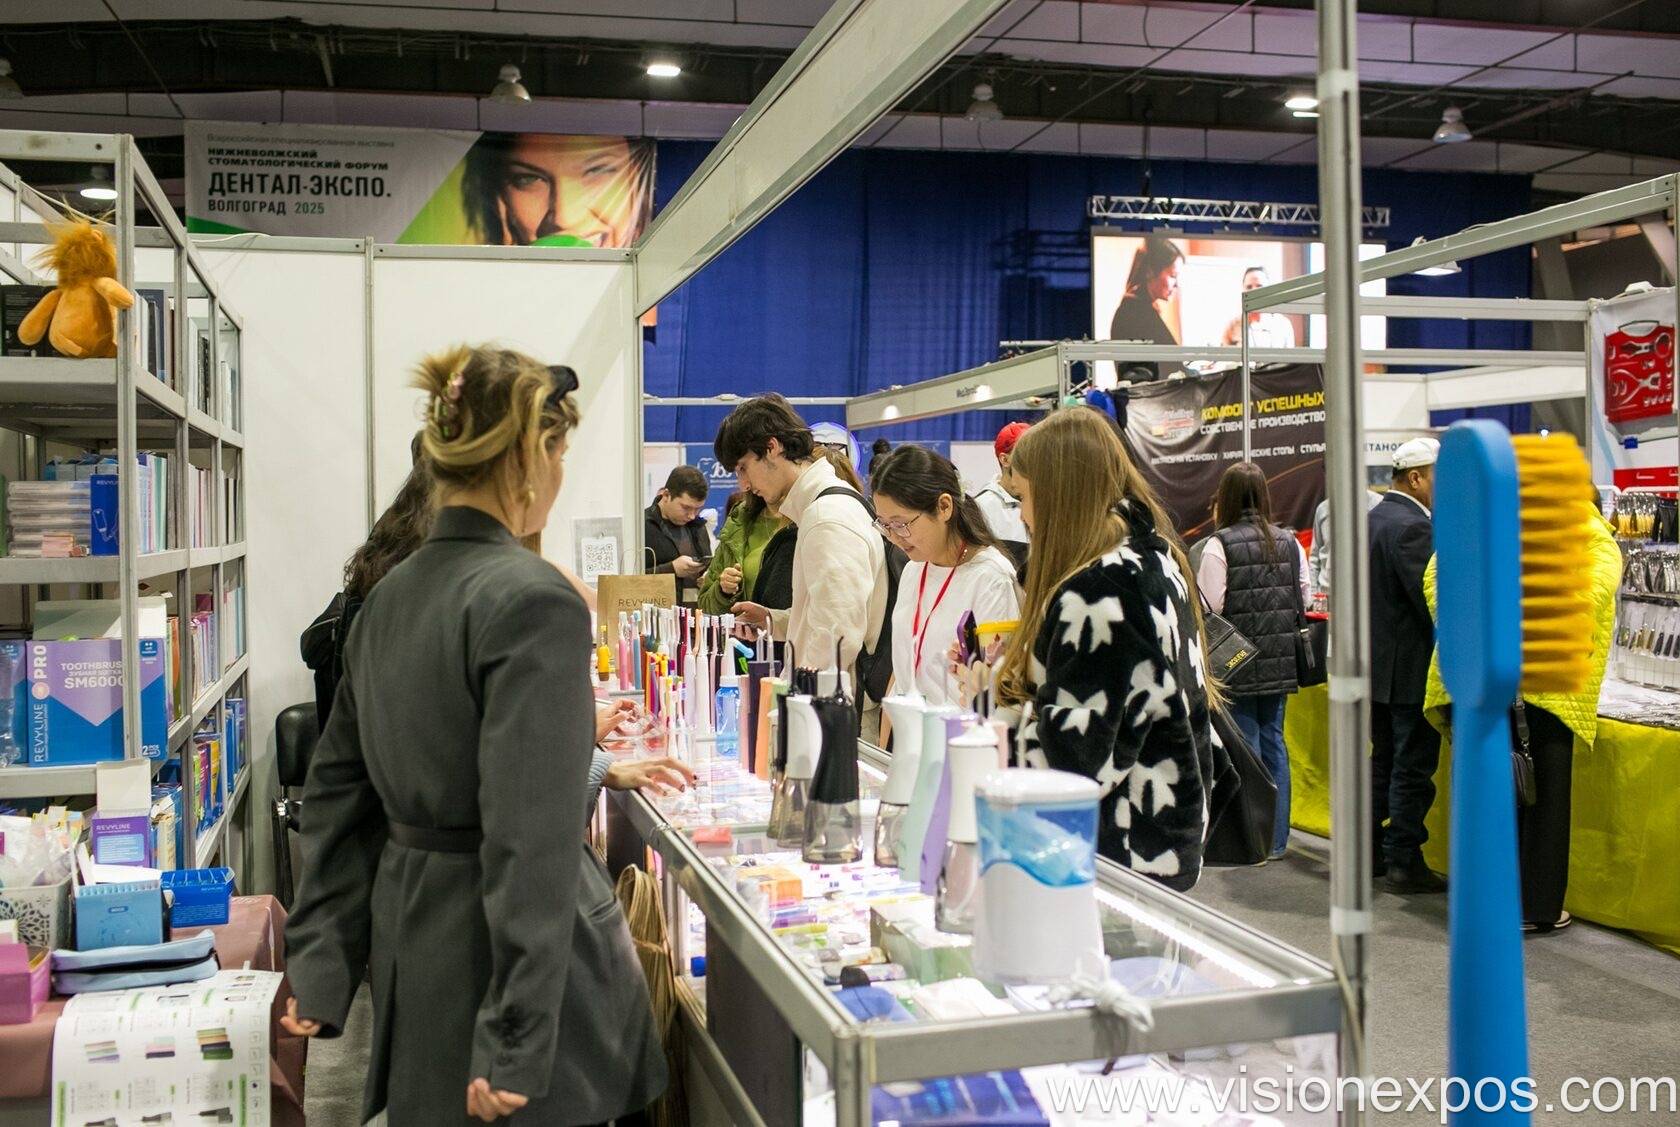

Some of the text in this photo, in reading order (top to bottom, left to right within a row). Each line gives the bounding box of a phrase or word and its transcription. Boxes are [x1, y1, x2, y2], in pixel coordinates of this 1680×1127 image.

[208, 148, 318, 158] НИЖНЕВОЛЖСКИЙ
[208, 157, 389, 170] СТОМАТОЛОГИЧЕСКИЙ ФОРУМ
[208, 172, 391, 197] ДЕНТАЛ-ЭКСПО.
[208, 199, 325, 215] ВОЛГОГРАД 2025
[1257, 391, 1325, 413] УСПЕШНЫХ
[1258, 411, 1326, 428] ПРОИЗВОДСТВО
[33, 645, 47, 679] PRO
[60, 661, 123, 671] TOOTHBRUS
[34, 703, 44, 763] REVYLINE
[142, 745, 149, 756] 2
